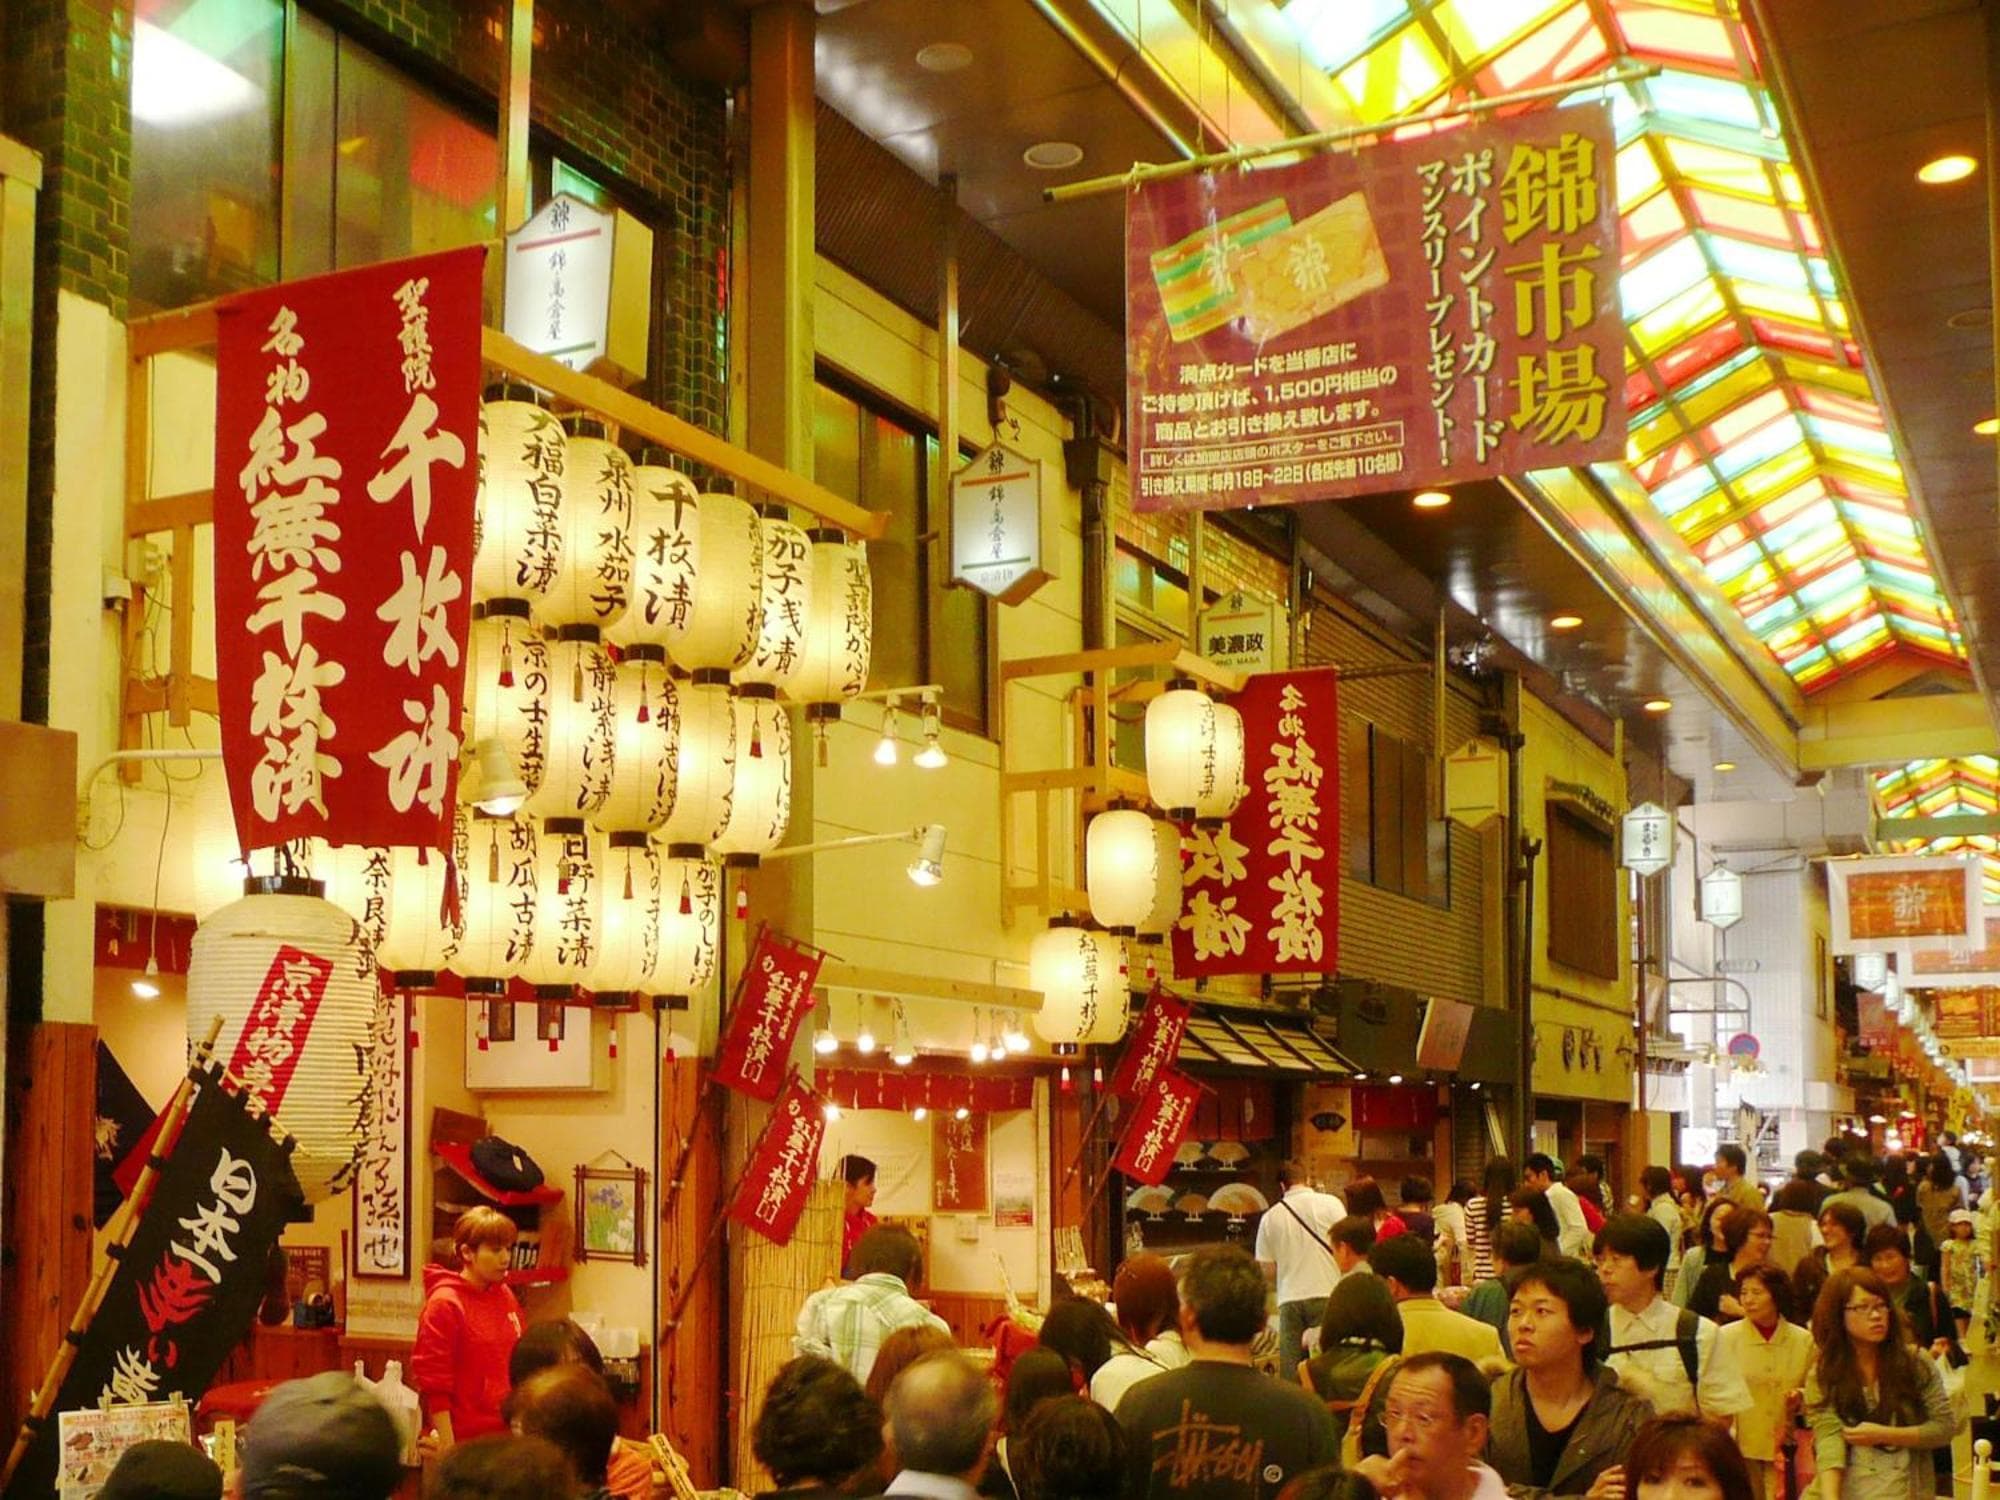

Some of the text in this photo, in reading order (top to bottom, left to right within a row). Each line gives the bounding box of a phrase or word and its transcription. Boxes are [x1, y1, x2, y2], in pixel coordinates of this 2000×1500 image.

[1180, 342, 1357, 385] 満点カードを当番店に
[1416, 160, 1455, 467] マンスリープレゼント!
[1451, 148, 1507, 464] ポイントカード
[1500, 131, 1608, 446] 錦市場
[645, 479, 698, 630] 千枚漬
